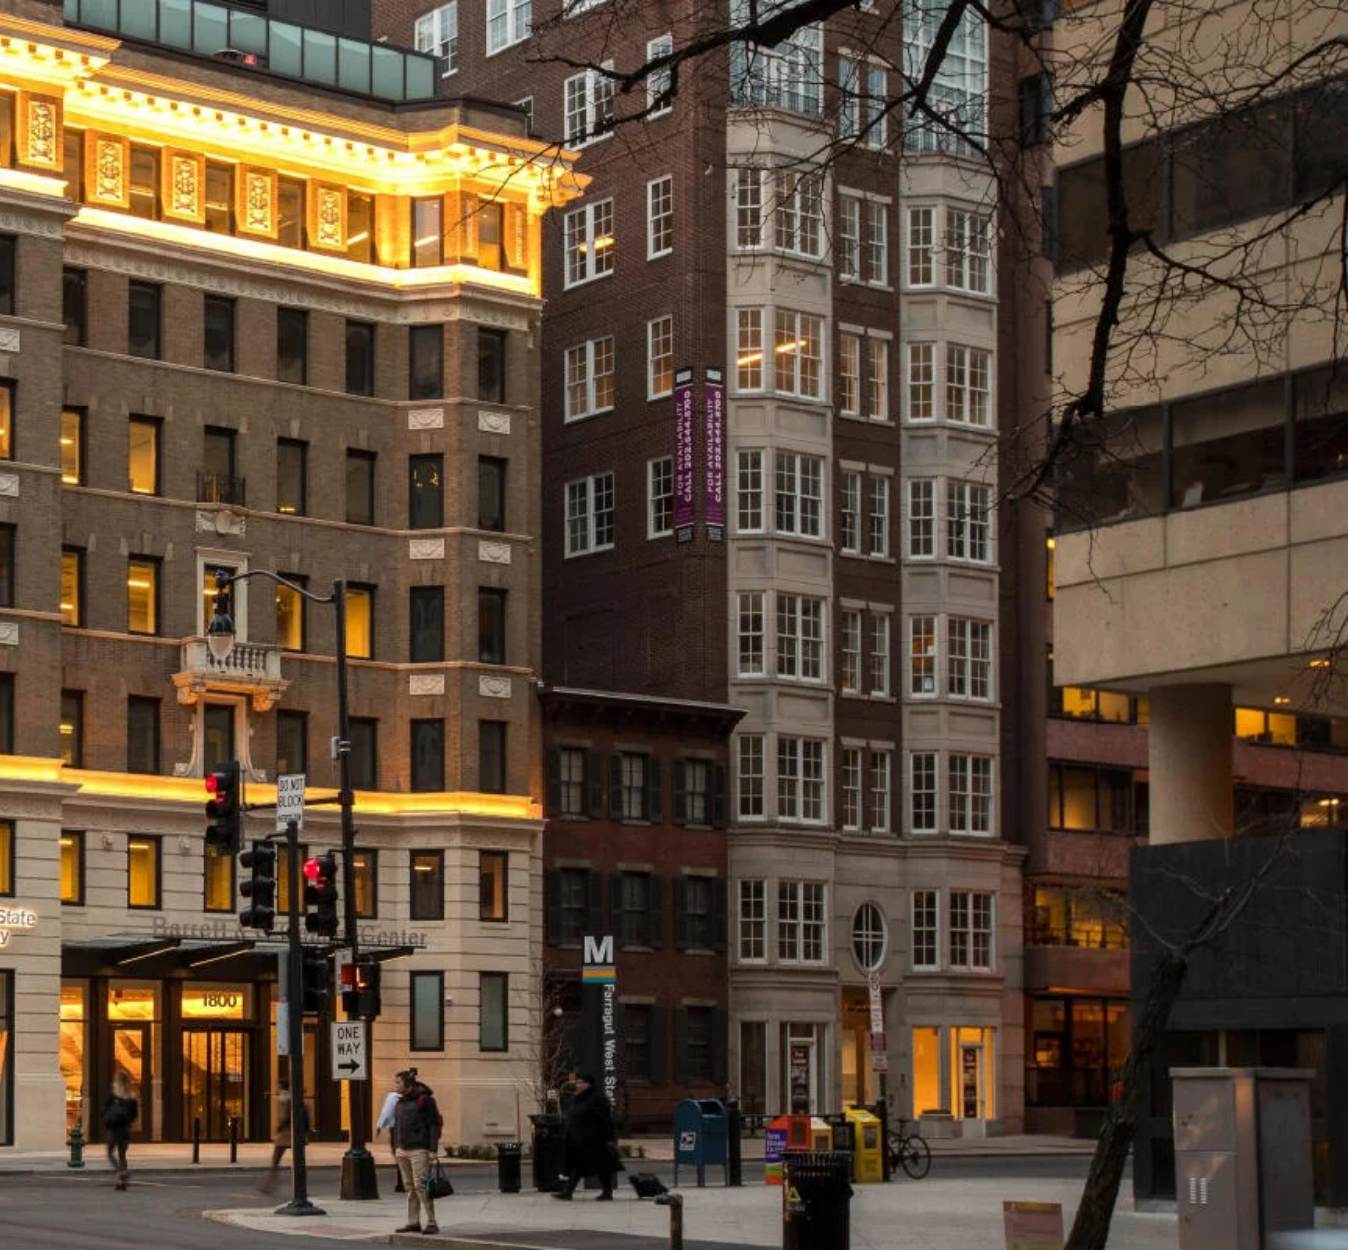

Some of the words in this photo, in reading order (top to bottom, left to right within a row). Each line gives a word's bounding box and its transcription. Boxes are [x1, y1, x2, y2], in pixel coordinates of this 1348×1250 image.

[684, 471, 692, 502] CALL
[153, 916, 226, 938] Barrett
[360, 927, 427, 945] Center
[584, 936, 613, 963] M
[203, 994, 238, 1008] 1800
[602, 984, 615, 1034] Farragut
[337, 1026, 360, 1040] ONE
[337, 1042, 361, 1056] WAY
[604, 1039, 617, 1071] West
